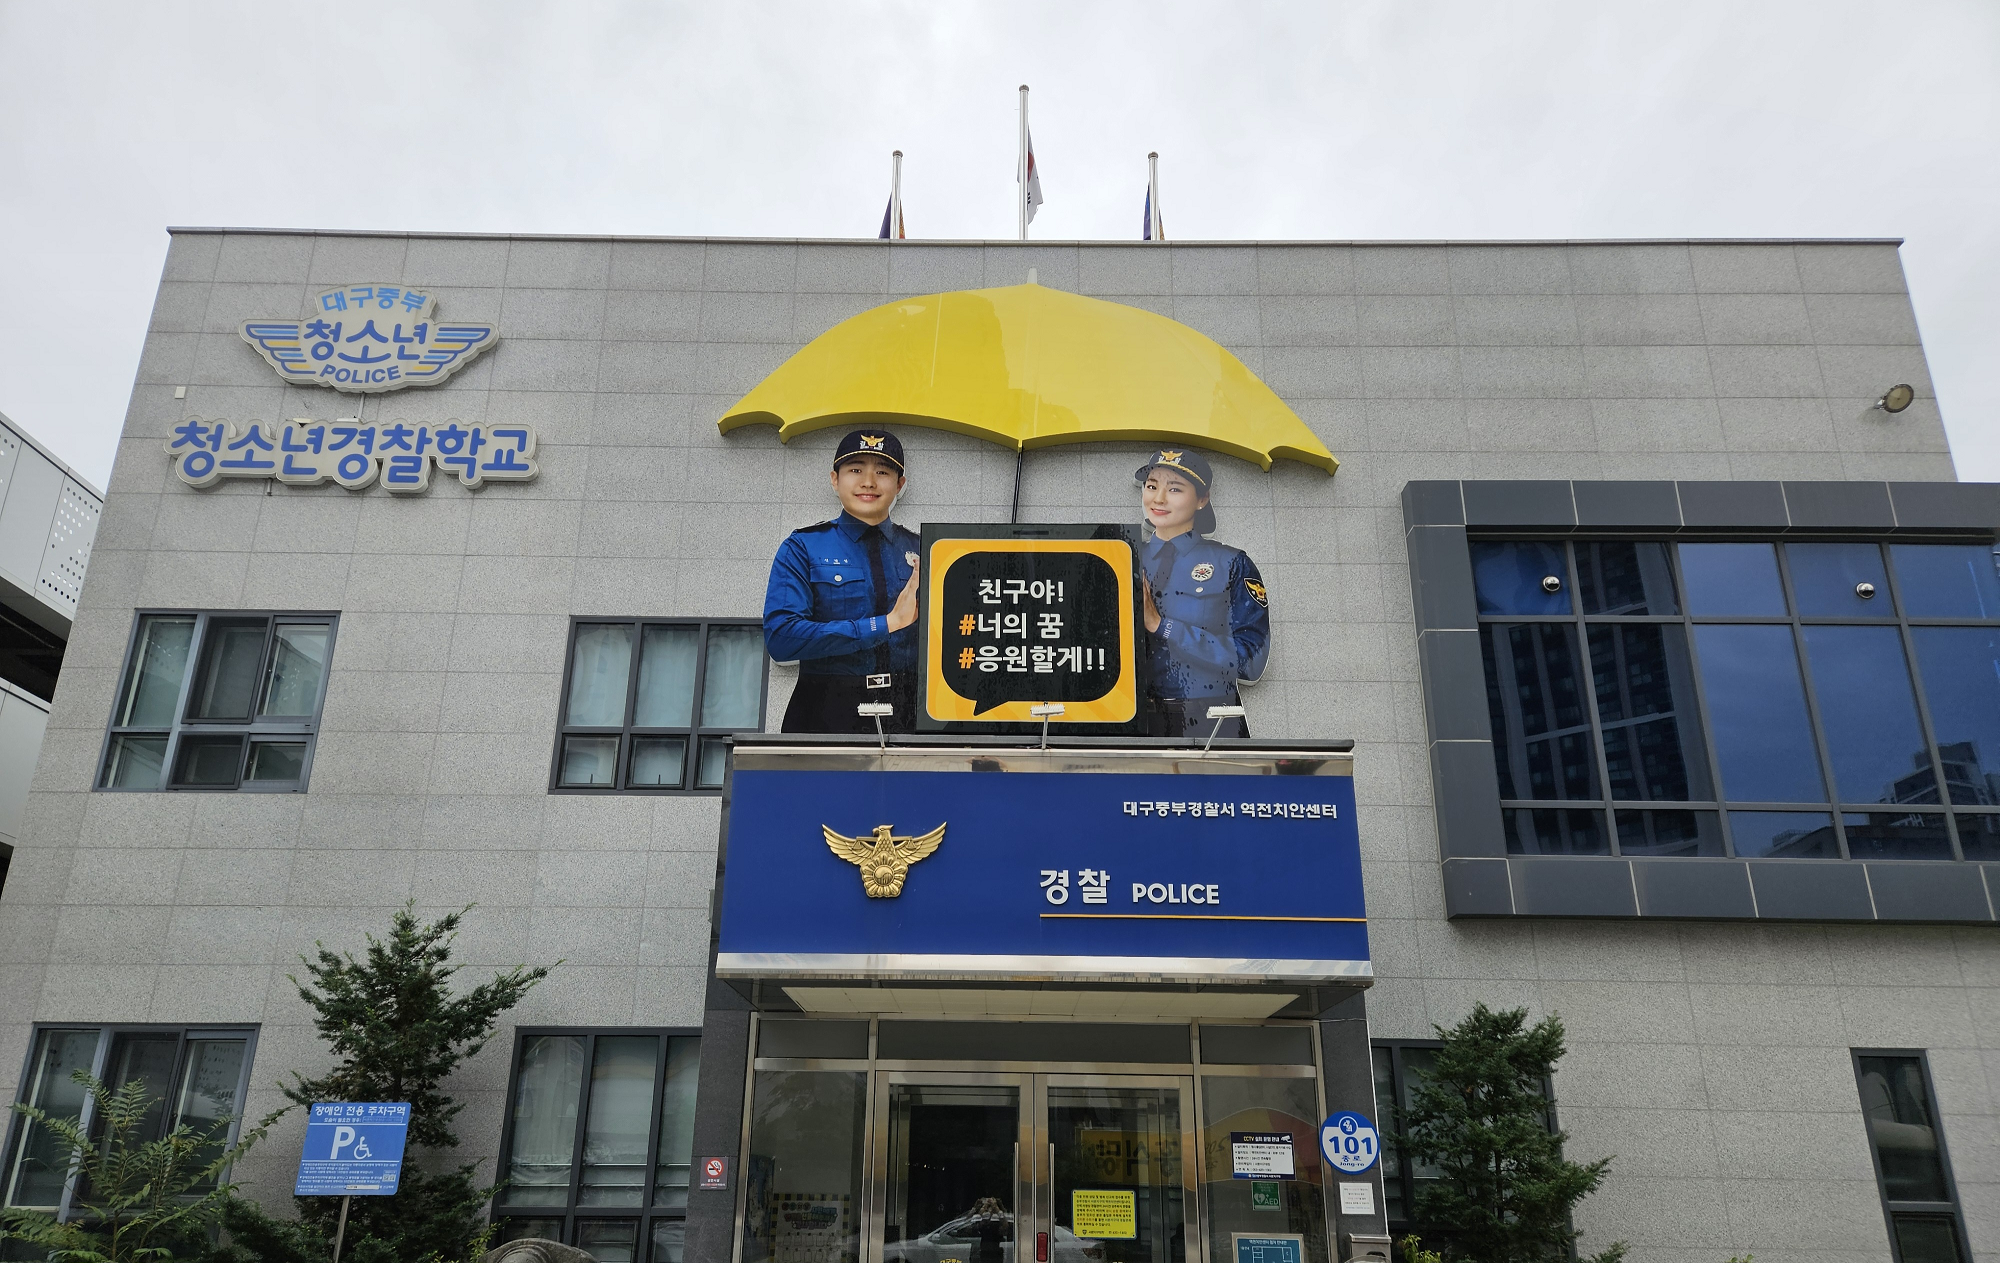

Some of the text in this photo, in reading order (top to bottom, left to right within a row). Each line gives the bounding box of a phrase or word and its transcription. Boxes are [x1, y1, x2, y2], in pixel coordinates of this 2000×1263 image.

[321, 287, 427, 313] 대구중부
[303, 318, 427, 363] 청소년
[319, 364, 401, 384] POLICE
[171, 420, 530, 483] 청소년경찰학교
[978, 578, 1064, 605] 친구야!
[959, 612, 1064, 639] #너의 꿈
[958, 645, 1105, 673] #응원할게!!
[1123, 801, 1338, 819] 대구중부경찰서 역전치안센터
[1132, 883, 1220, 904] POLICE
[315, 1106, 406, 1116] 장애인 전용 주차구역
[330, 1126, 355, 1160] P
[1329, 1136, 1373, 1155] 101
